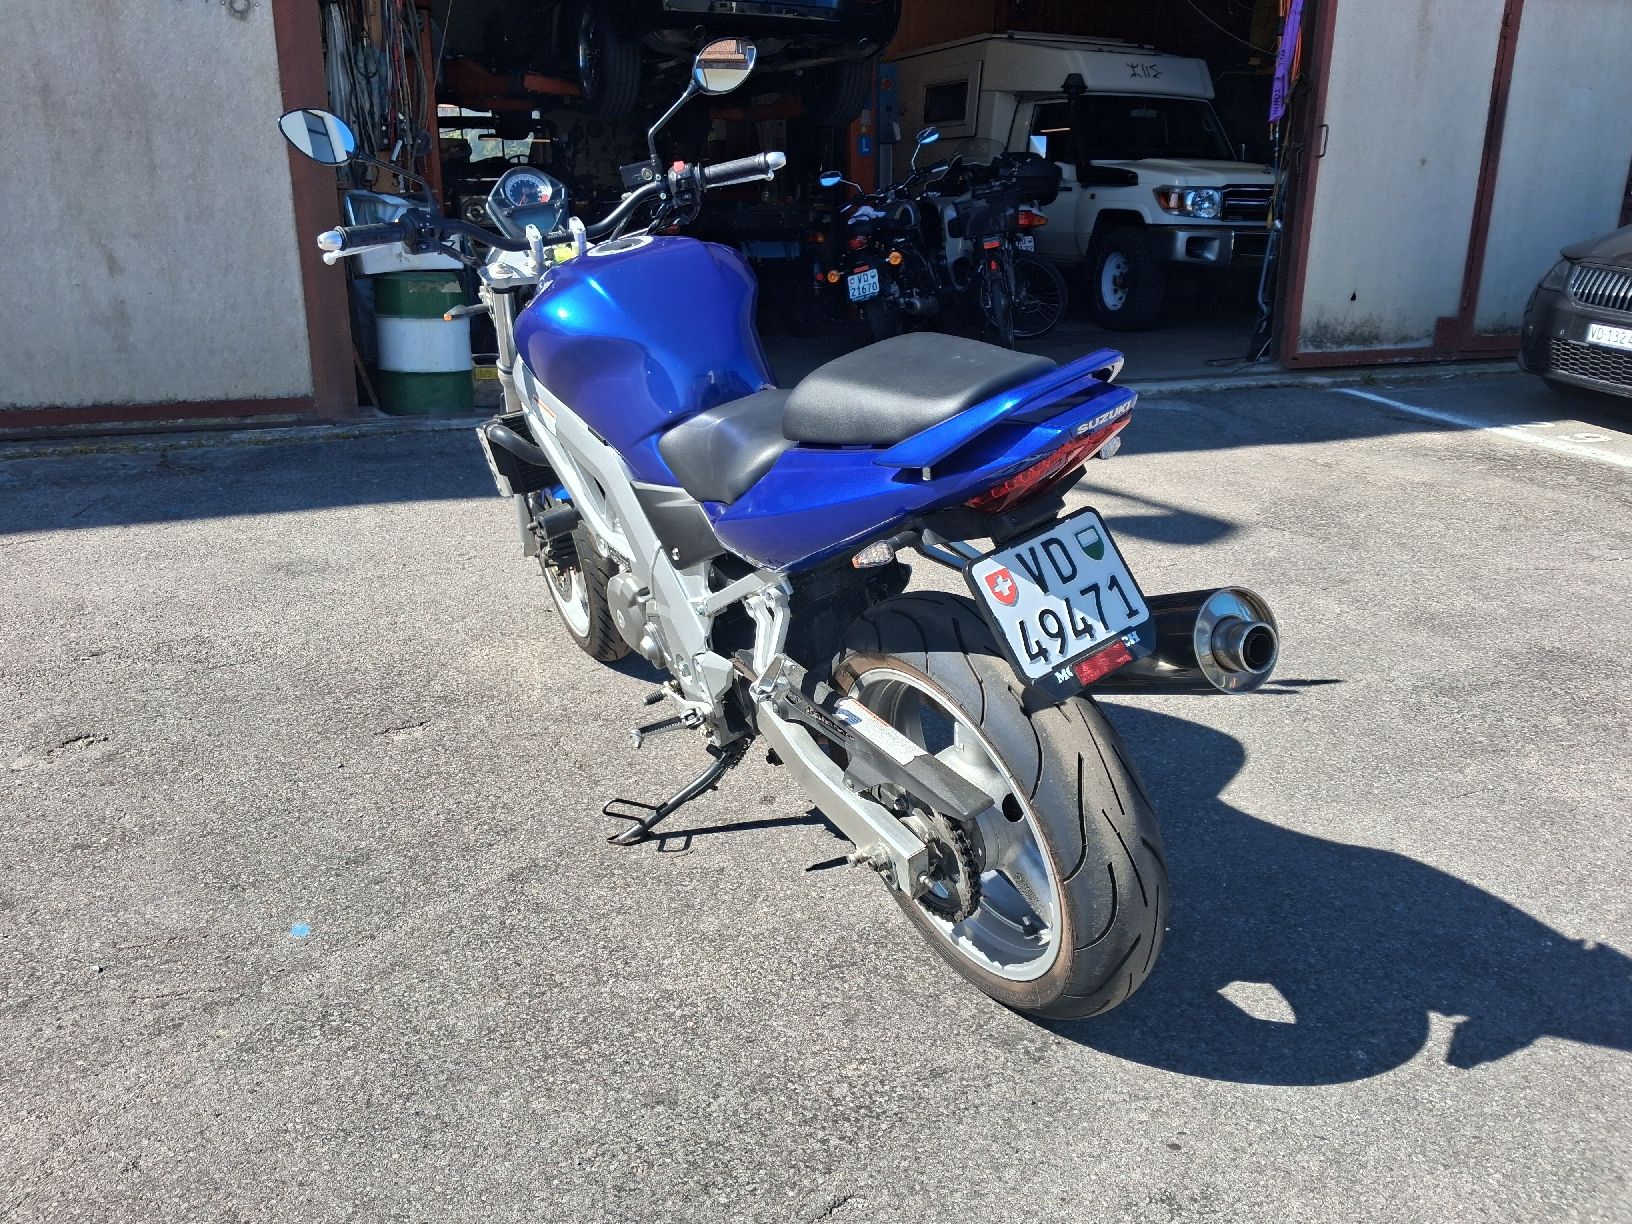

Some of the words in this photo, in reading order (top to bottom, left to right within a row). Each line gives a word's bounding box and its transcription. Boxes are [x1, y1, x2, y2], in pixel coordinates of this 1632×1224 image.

[850, 282, 878, 297] 21670
[857, 273, 869, 284] VD
[1076, 400, 1132, 435] SUZUKI
[1015, 537, 1078, 594] VD
[1018, 574, 1140, 663] 49471
